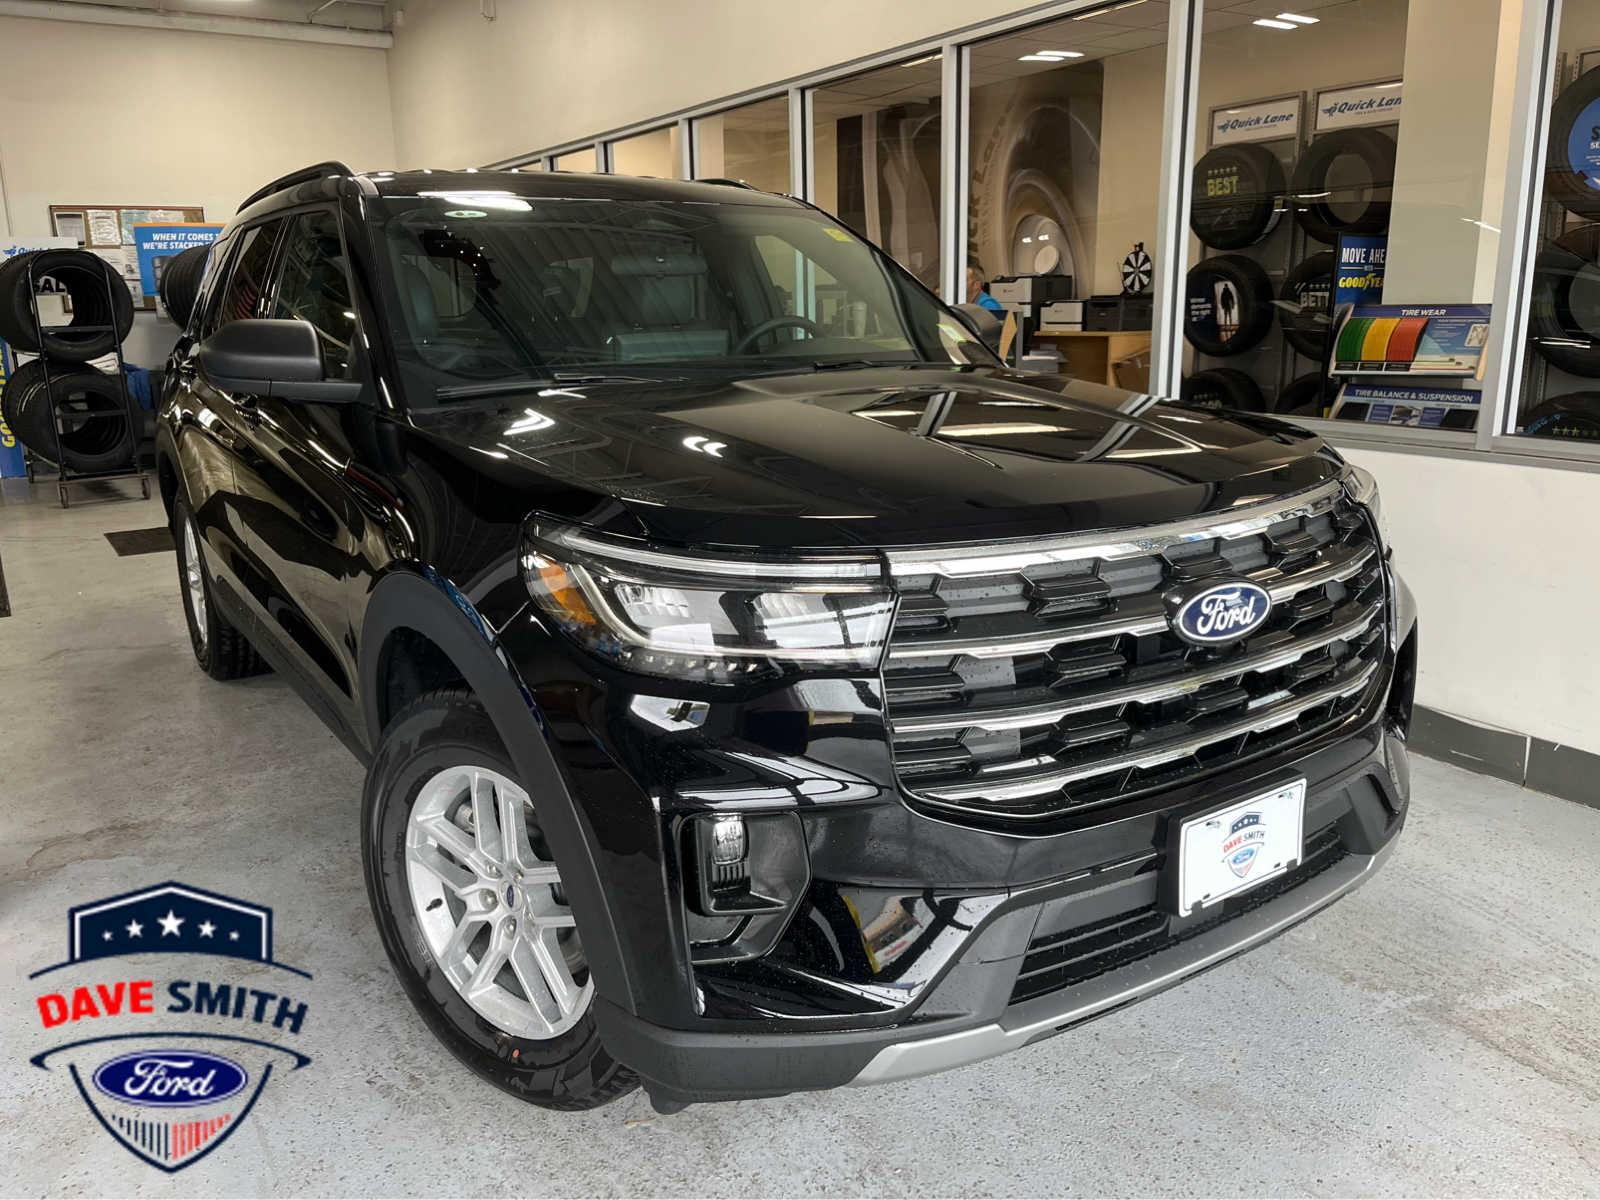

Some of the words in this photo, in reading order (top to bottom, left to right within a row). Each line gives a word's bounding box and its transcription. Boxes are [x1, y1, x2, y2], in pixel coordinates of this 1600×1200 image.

[1337, 98, 1374, 114] Quick
[1230, 116, 1262, 131] Quick
[1264, 113, 1294, 125] Lane
[1207, 176, 1239, 197] BEST
[143, 241, 168, 250] WE'RE
[152, 233, 176, 241] WHEN
[1341, 247, 1367, 264] MOVE
[1354, 389, 1371, 397] TIRE
[1372, 390, 1410, 399] BALANCE
[1410, 391, 1417, 399] &
[1417, 392, 1474, 403] SUSPENSION
[1197, 593, 1256, 635] Ford
[1223, 836, 1243, 854] DAVE
[1243, 830, 1266, 842] SMITH
